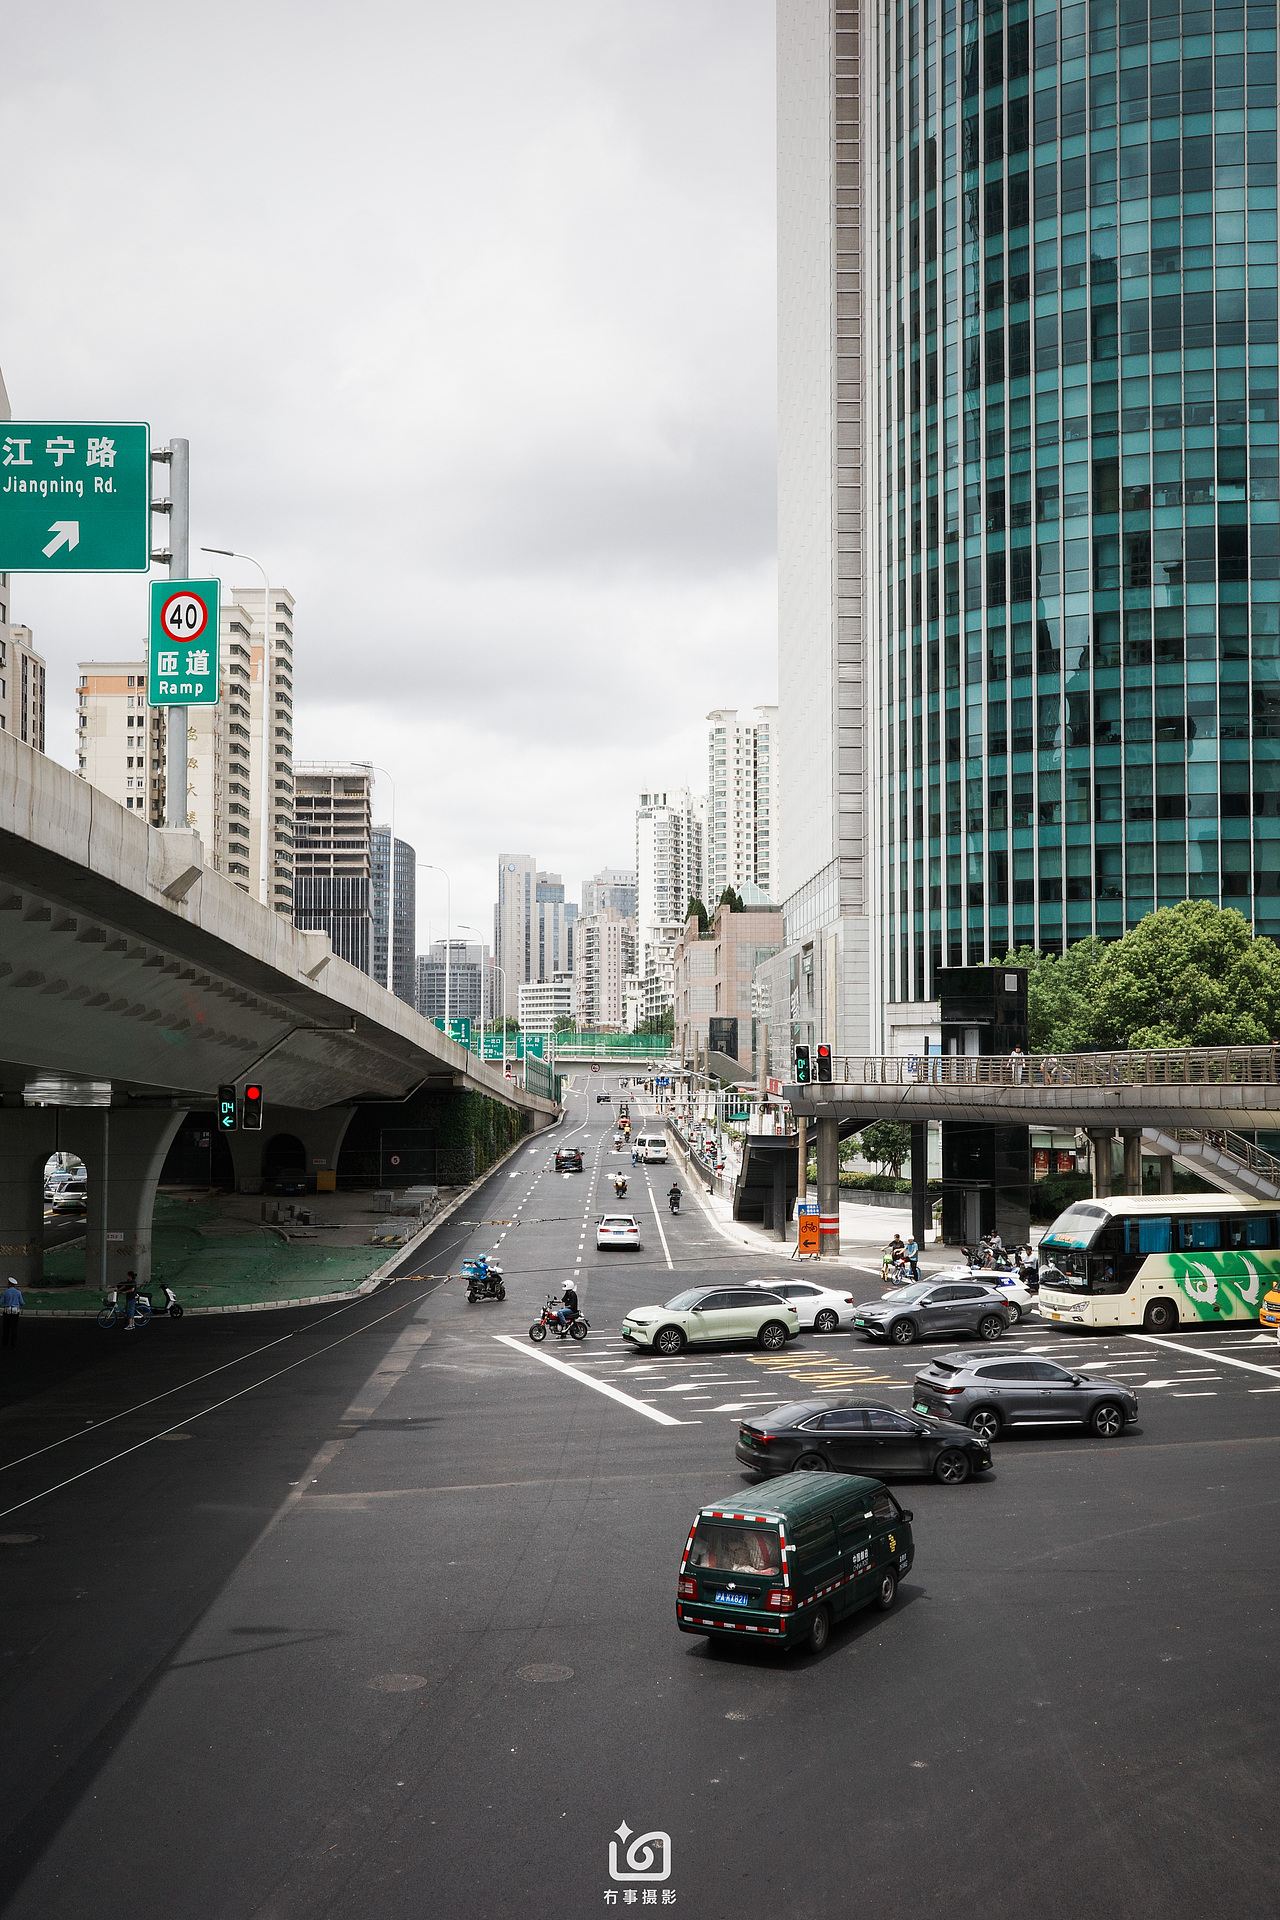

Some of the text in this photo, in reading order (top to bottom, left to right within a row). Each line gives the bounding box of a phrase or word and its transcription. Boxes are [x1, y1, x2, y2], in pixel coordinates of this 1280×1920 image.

[2, 436, 117, 467] 江宁路
[3, 476, 117, 497] Jiangning Rd.
[169, 603, 198, 629] 40
[157, 650, 210, 676] 匝道
[159, 681, 204, 697] Ramp
[221, 1102, 234, 1113] 04
